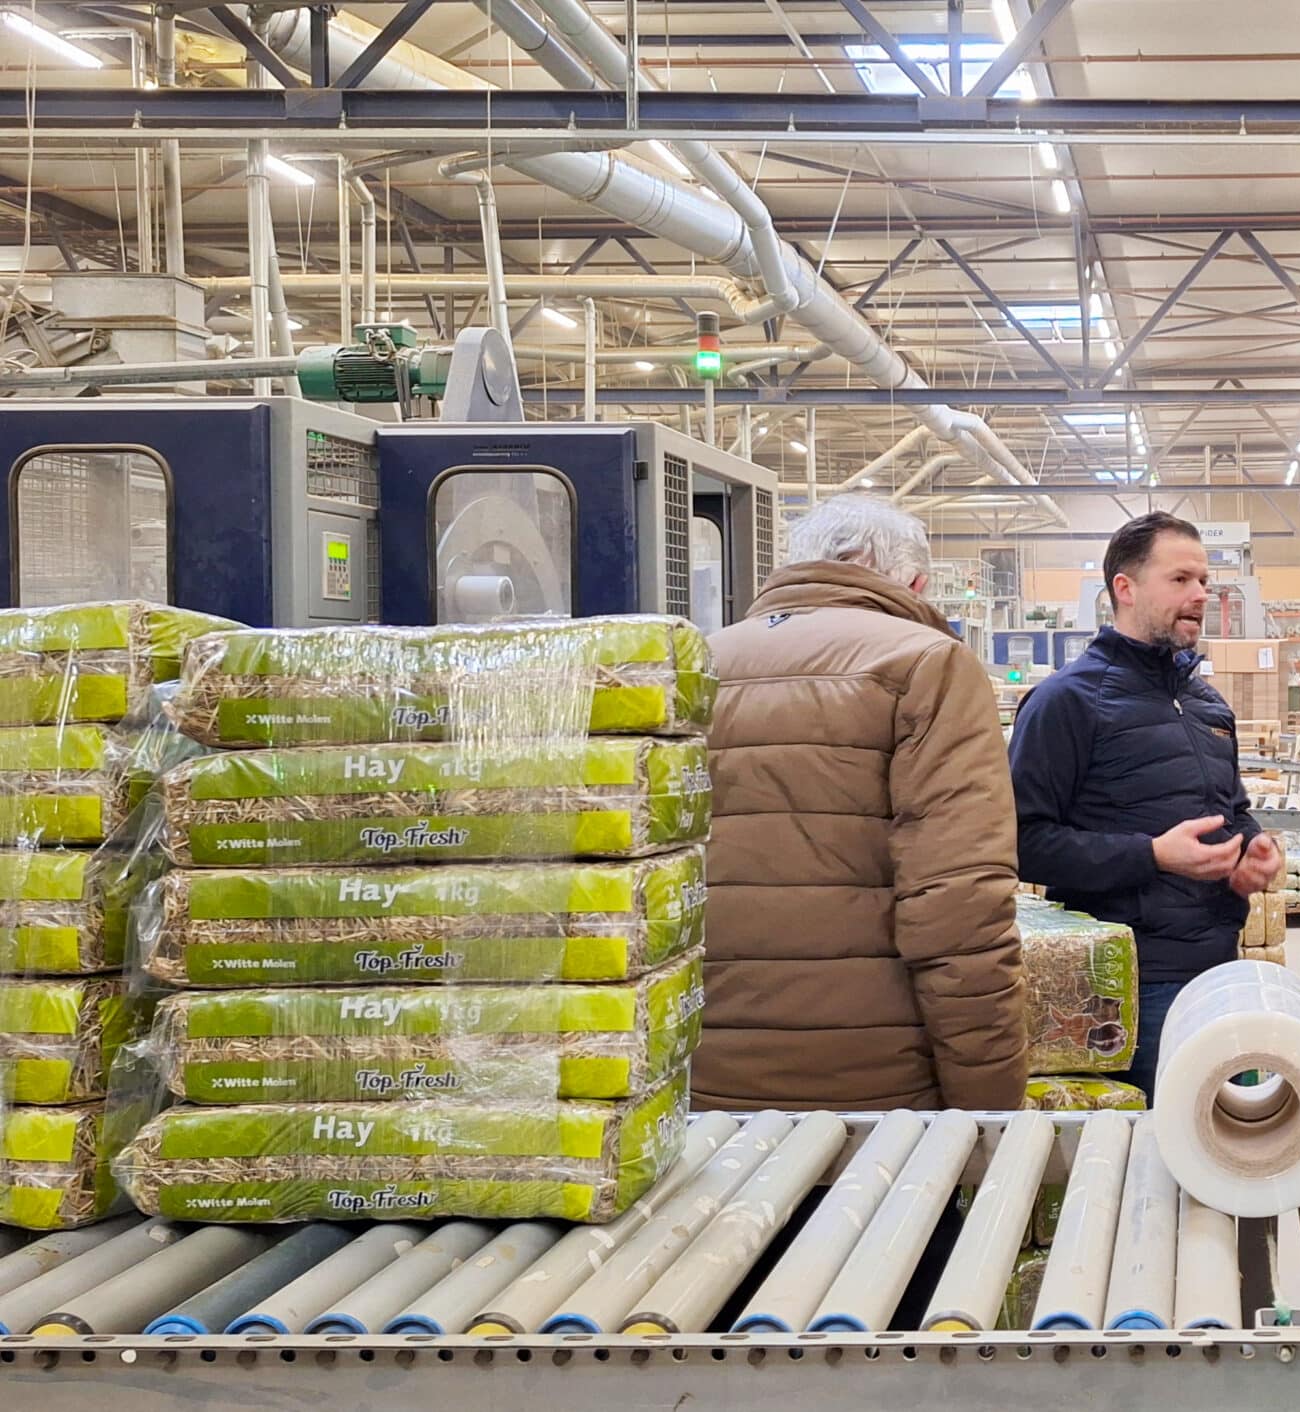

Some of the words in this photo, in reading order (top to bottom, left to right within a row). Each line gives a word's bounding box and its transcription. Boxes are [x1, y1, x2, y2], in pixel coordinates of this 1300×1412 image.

[258, 714, 294, 725] Witte
[344, 755, 405, 784] Hay
[229, 838, 265, 850] Witte
[267, 837, 302, 848] Molen
[404, 820, 468, 848] Fresh
[339, 877, 400, 909] Hay
[224, 958, 260, 969] Witte
[262, 958, 297, 969] Molen
[399, 944, 463, 970] Fresh
[340, 996, 402, 1026] Hay
[224, 1077, 260, 1088] Witte
[262, 1077, 297, 1087] Molen
[400, 1063, 464, 1089] Fresh
[313, 1115, 375, 1147] Hay
[198, 1198, 234, 1209] Witte
[236, 1197, 271, 1208] Molen
[373, 1184, 437, 1210] Fresh
